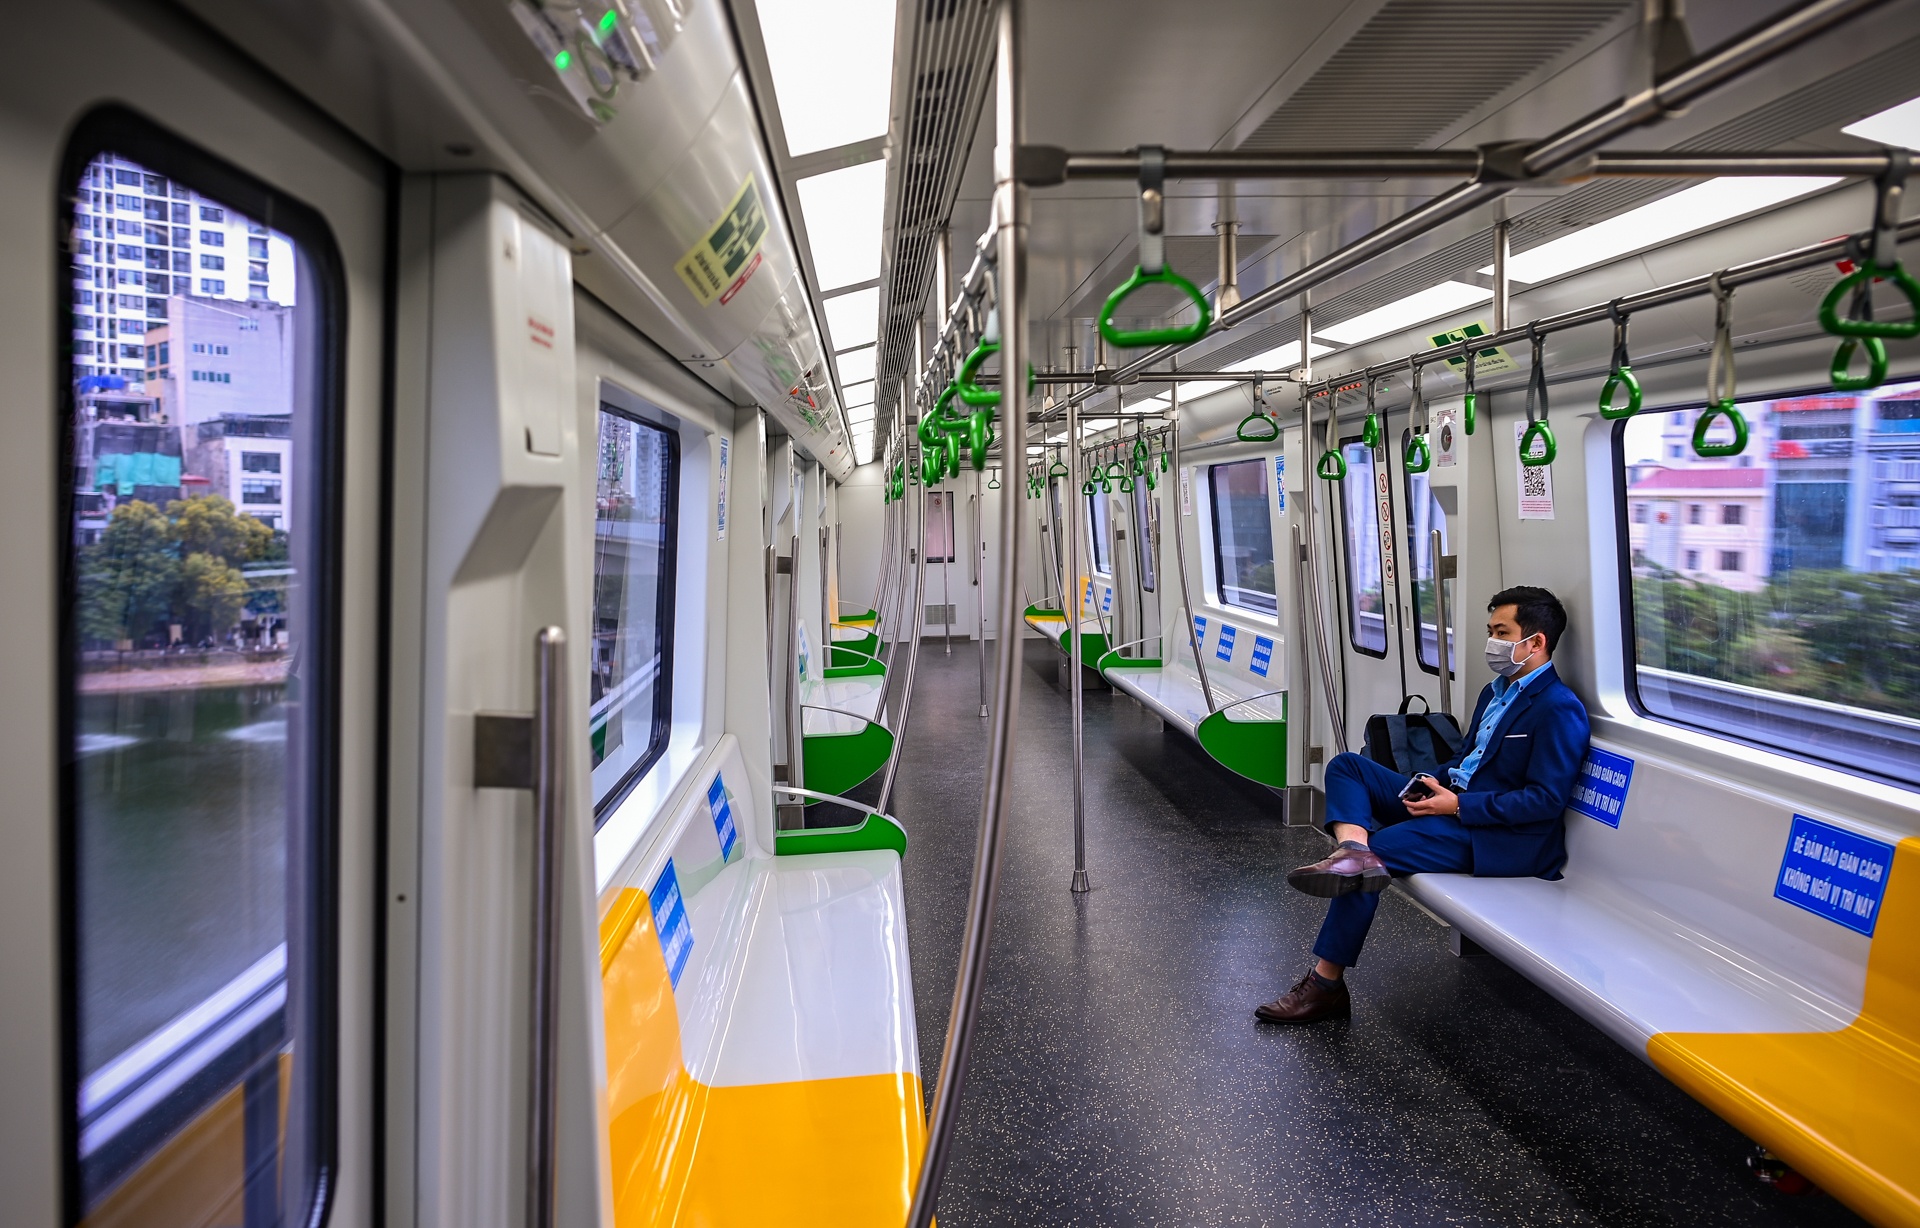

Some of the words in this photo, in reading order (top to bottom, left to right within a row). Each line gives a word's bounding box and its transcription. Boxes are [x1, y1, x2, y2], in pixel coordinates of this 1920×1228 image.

[1792, 831, 1808, 854] ĐỂ
[1803, 834, 1823, 861] ĐẢM
[1821, 840, 1839, 867] BẢO
[1837, 851, 1860, 875] GIÃN
[1858, 857, 1884, 883] CÁCH
[1782, 866, 1811, 894] KHÔNG
[1829, 884, 1842, 910] VỊ
[1839, 888, 1858, 912] TRÍ
[1853, 893, 1876, 919] NÀY
